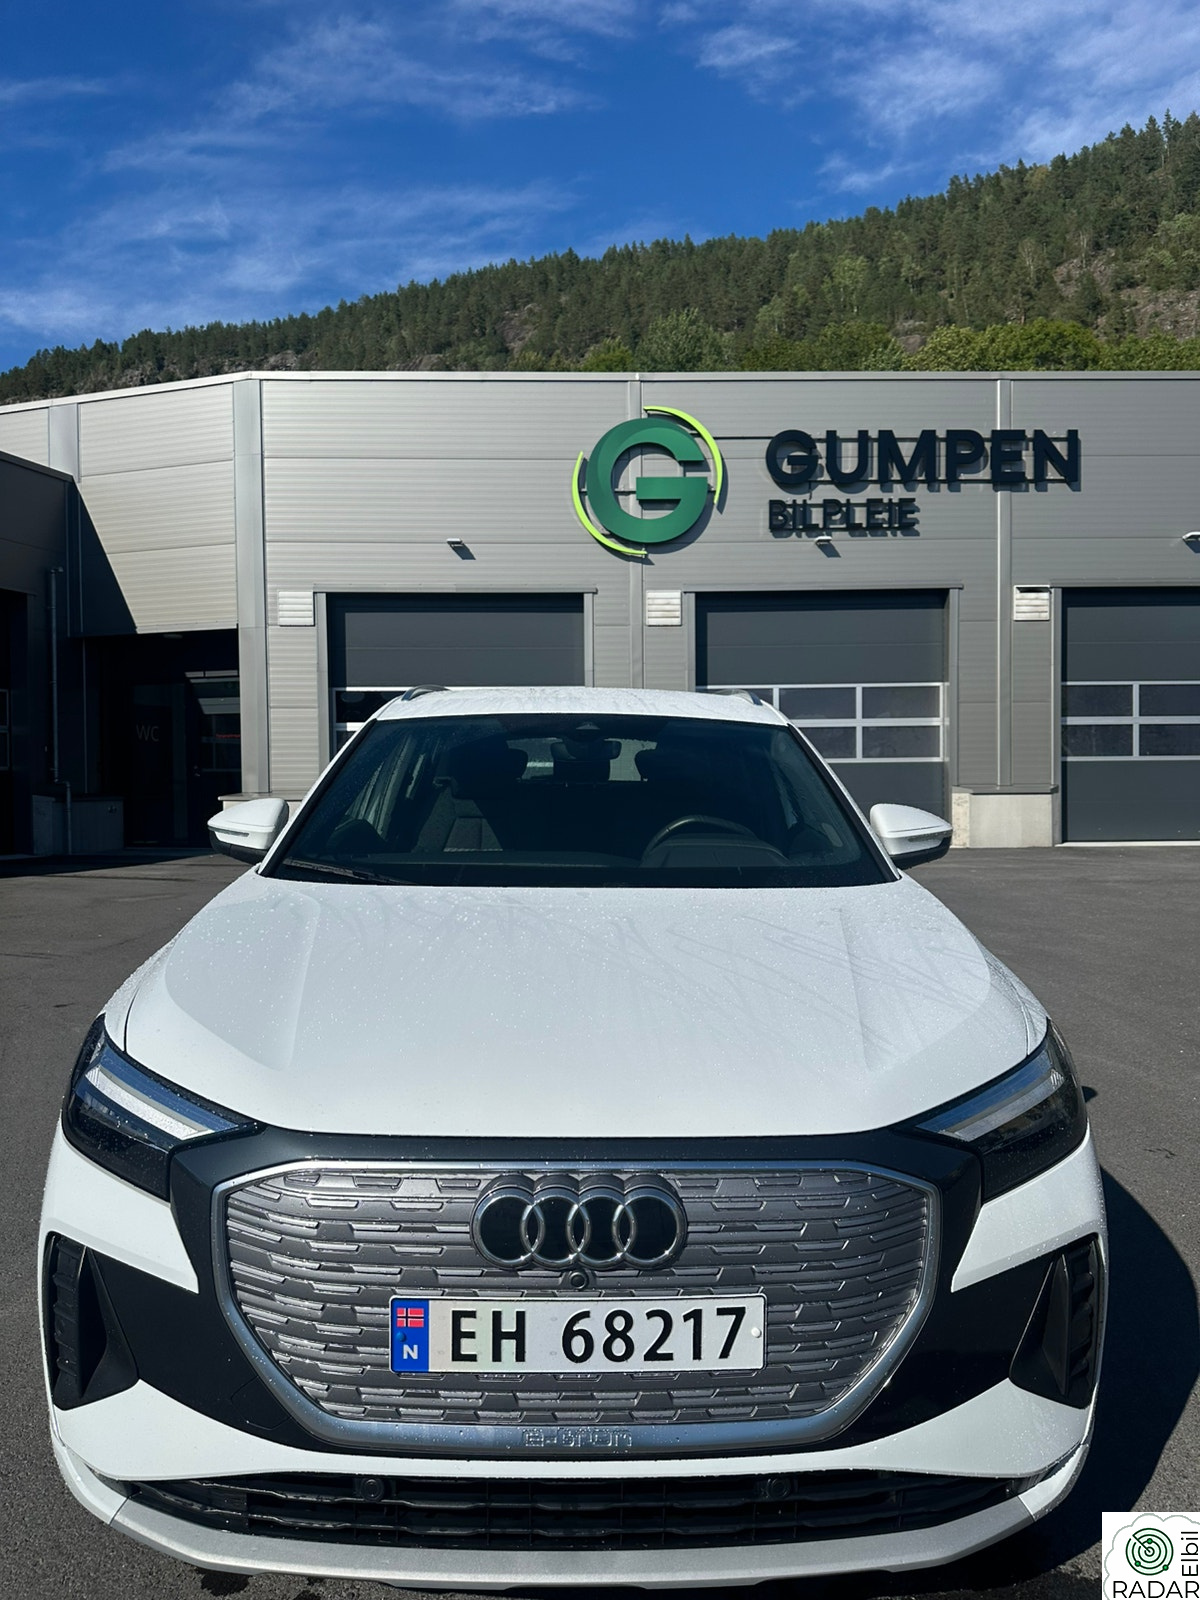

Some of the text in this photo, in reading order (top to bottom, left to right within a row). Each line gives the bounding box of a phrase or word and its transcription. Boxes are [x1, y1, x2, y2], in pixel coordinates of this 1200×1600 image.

[765, 429, 1079, 485] GUMPEN
[586, 417, 708, 543] G
[768, 498, 917, 531] BILPLEIE
[135, 723, 160, 742] WC
[403, 1344, 418, 1360] N
[451, 1306, 746, 1363] EH 68217
